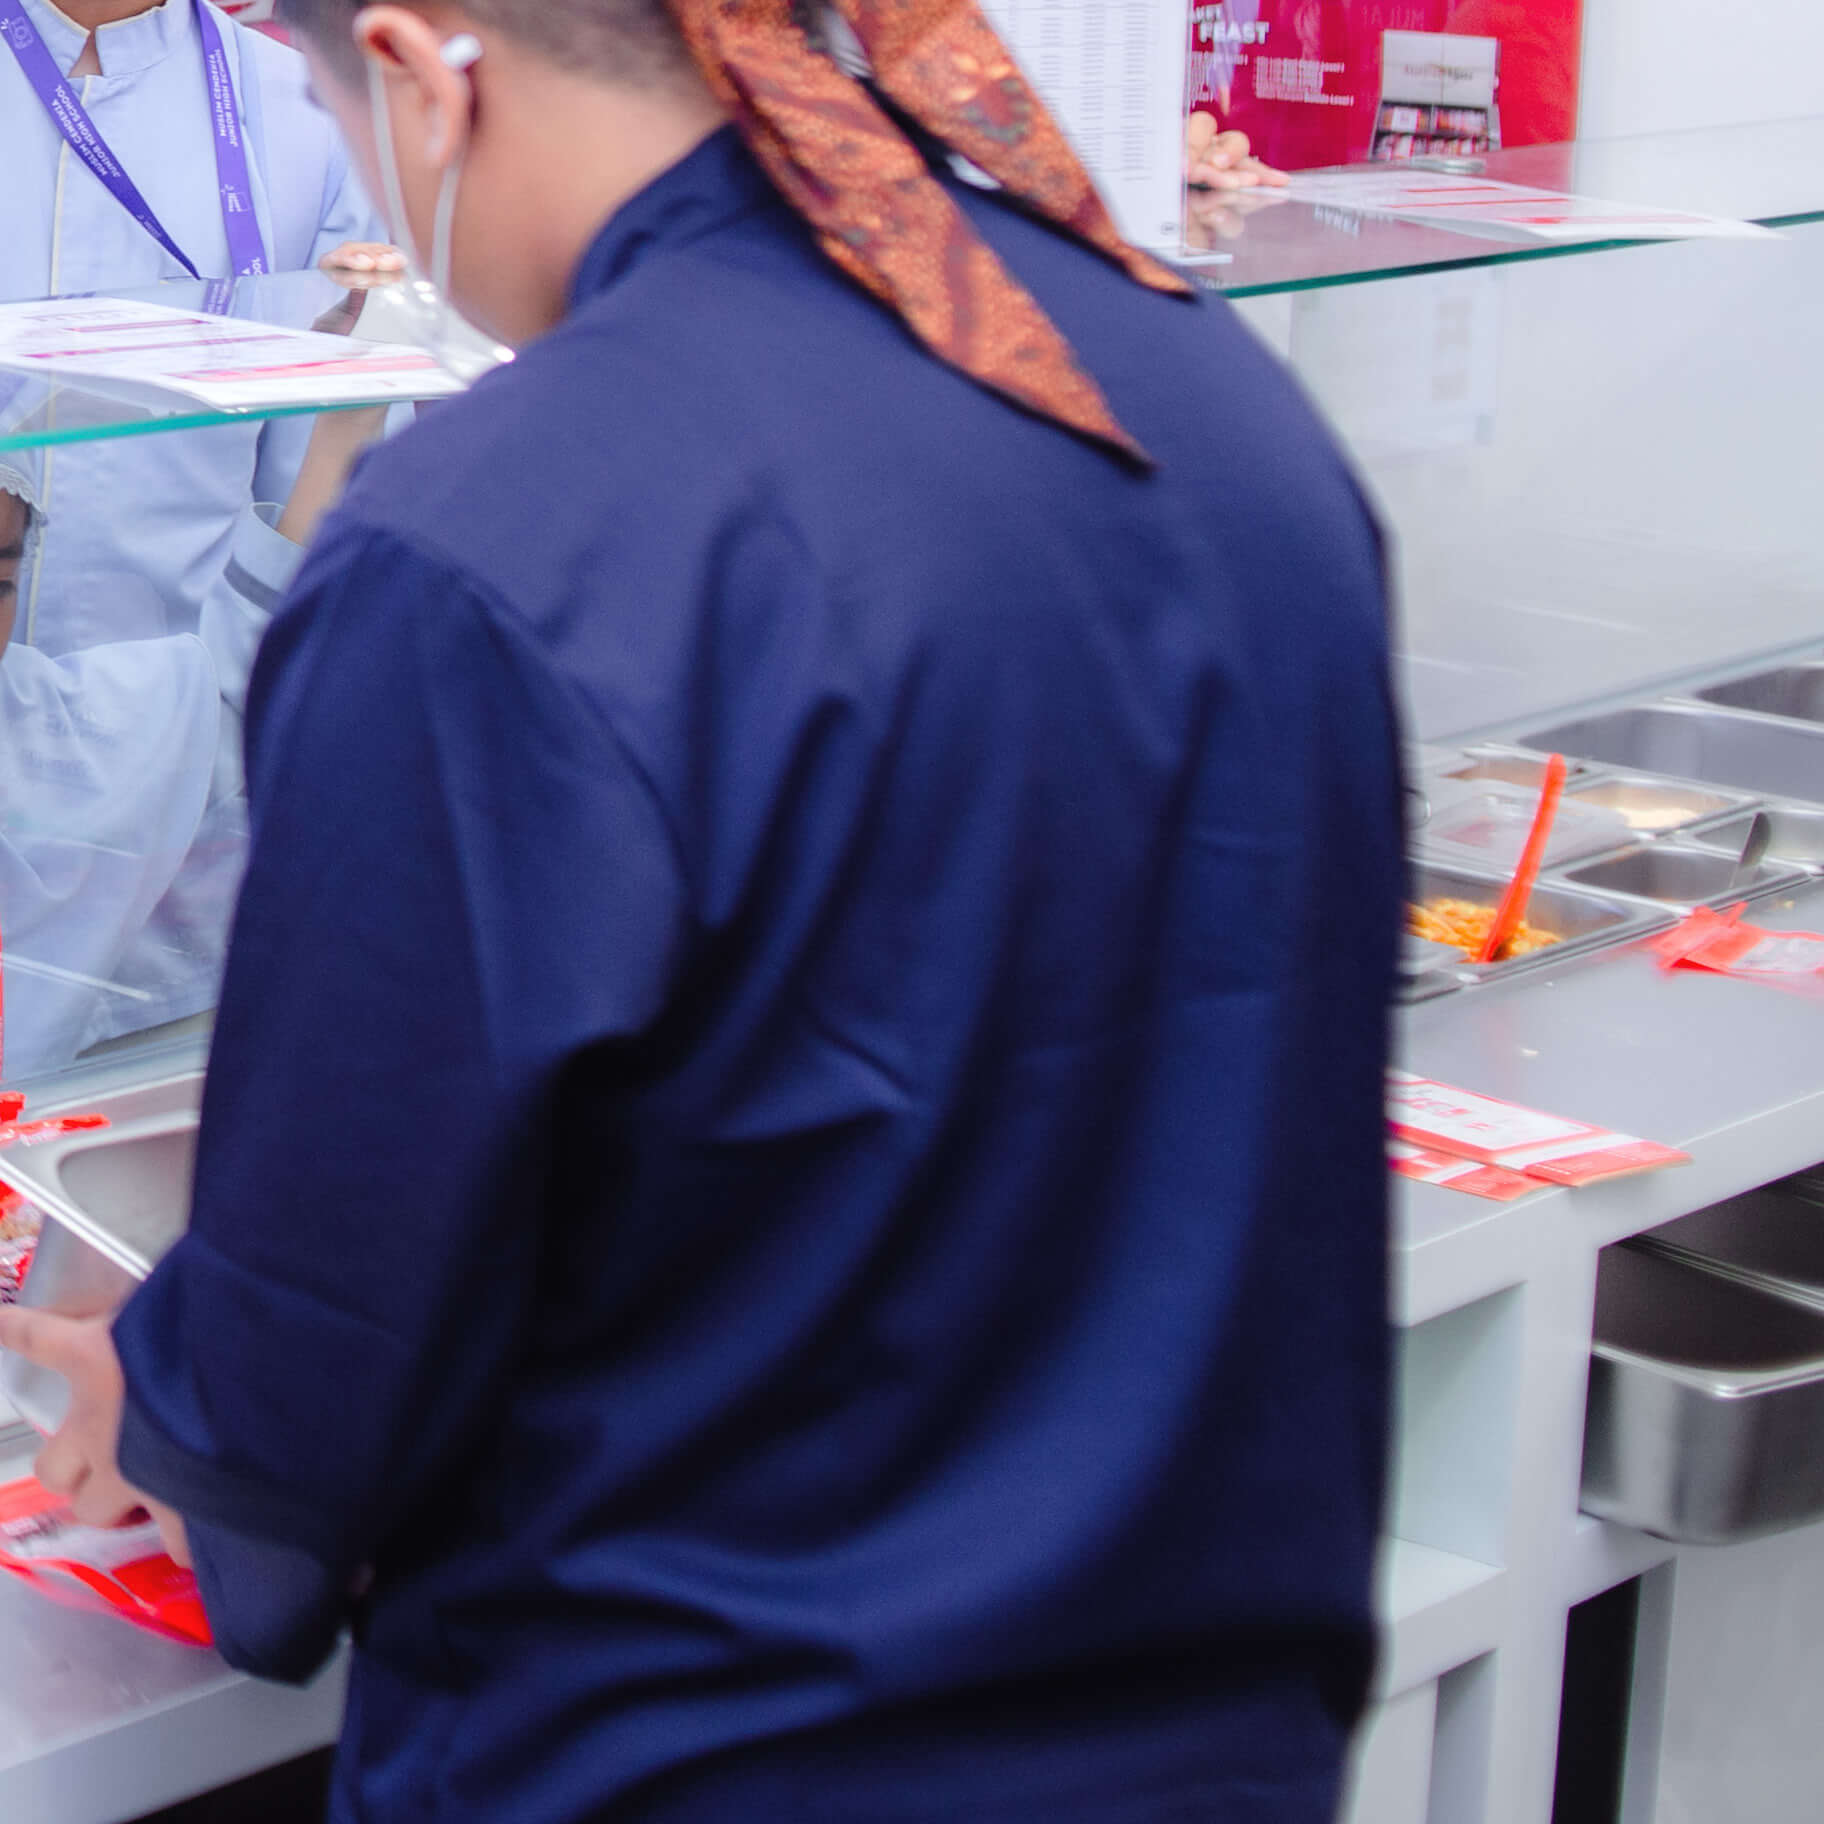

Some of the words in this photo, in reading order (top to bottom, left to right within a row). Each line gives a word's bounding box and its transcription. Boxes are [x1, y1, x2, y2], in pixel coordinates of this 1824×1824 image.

[1200, 21, 1270, 44] FEAST
[50, 97, 83, 144] CENDEKIA
[54, 83, 82, 122] SCHOOL
[215, 100, 227, 137] MUSLIM
[76, 119, 97, 146] HIGH
[78, 142, 108, 176] MUSLIM
[92, 143, 121, 179] JUNIOR
